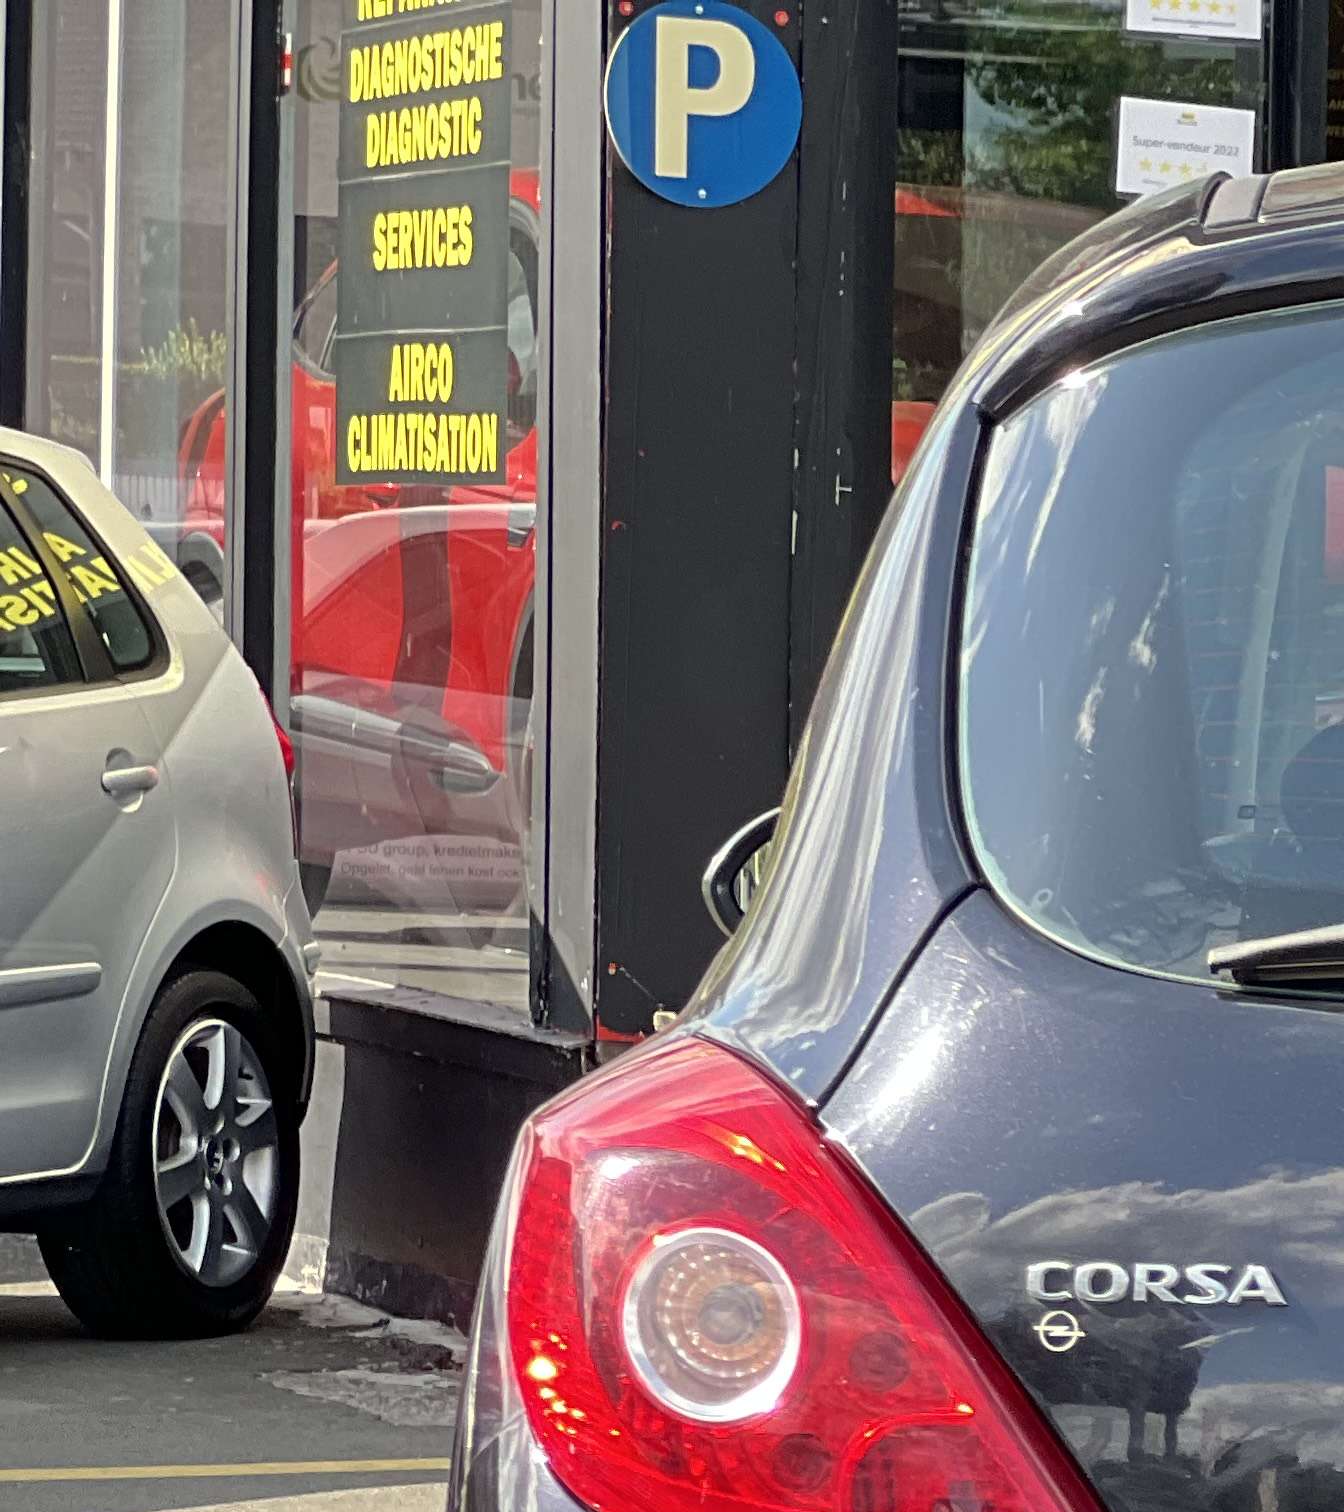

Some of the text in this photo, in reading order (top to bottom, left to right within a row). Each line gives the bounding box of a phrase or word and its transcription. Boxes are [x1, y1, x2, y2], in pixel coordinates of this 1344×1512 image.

[349, 20, 504, 103] DIAGNOSTISCHE
[654, 15, 756, 180] P
[366, 96, 482, 168] DIAGNOSTIC
[372, 205, 472, 272] SERVICES
[389, 342, 454, 403] AIRCO
[347, 412, 498, 474] CLIMATISATION
[1025, 1260, 1289, 1307] CORSA
